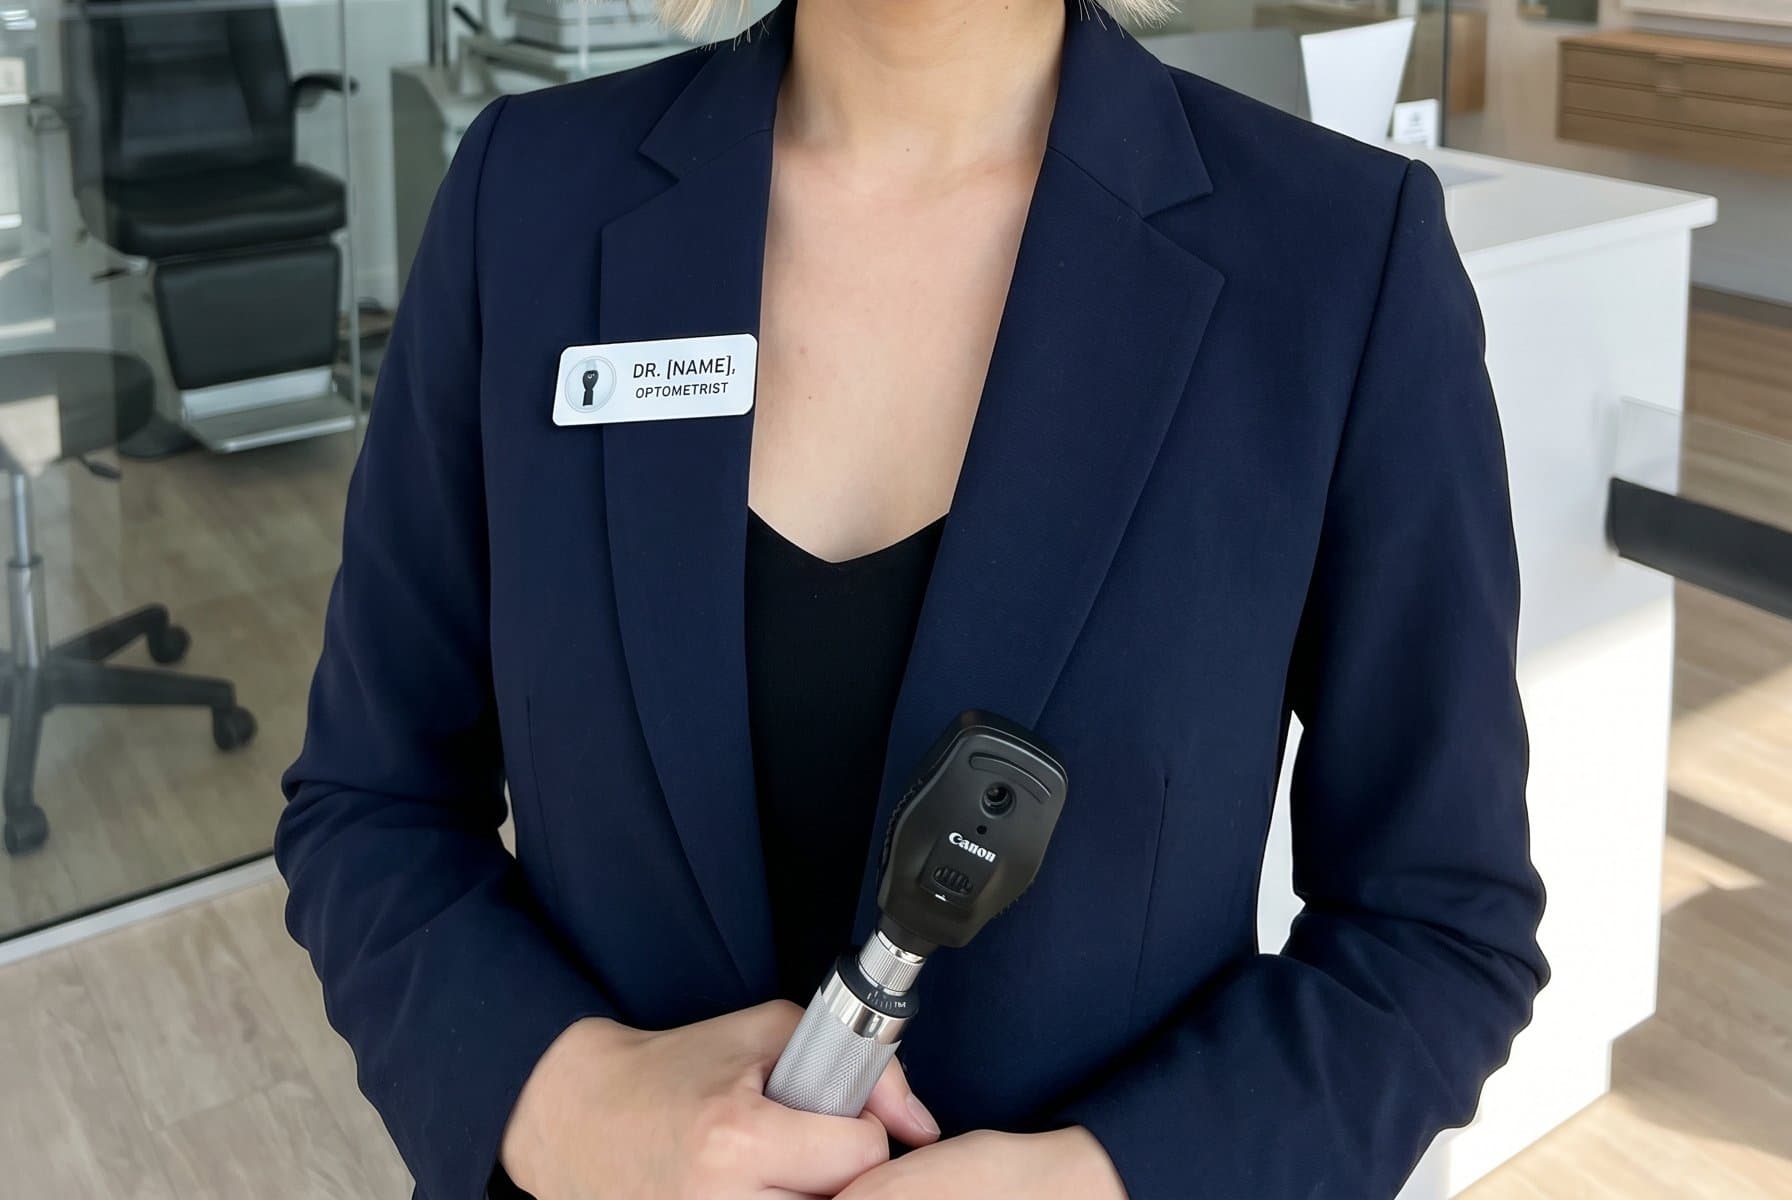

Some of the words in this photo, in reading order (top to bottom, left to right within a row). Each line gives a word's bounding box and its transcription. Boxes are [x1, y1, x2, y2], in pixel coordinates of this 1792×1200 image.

[633, 362, 660, 378] DR.
[667, 355, 736, 379] [NAME],
[635, 382, 729, 399] OPTOMETRIST
[948, 832, 997, 863] Canon
